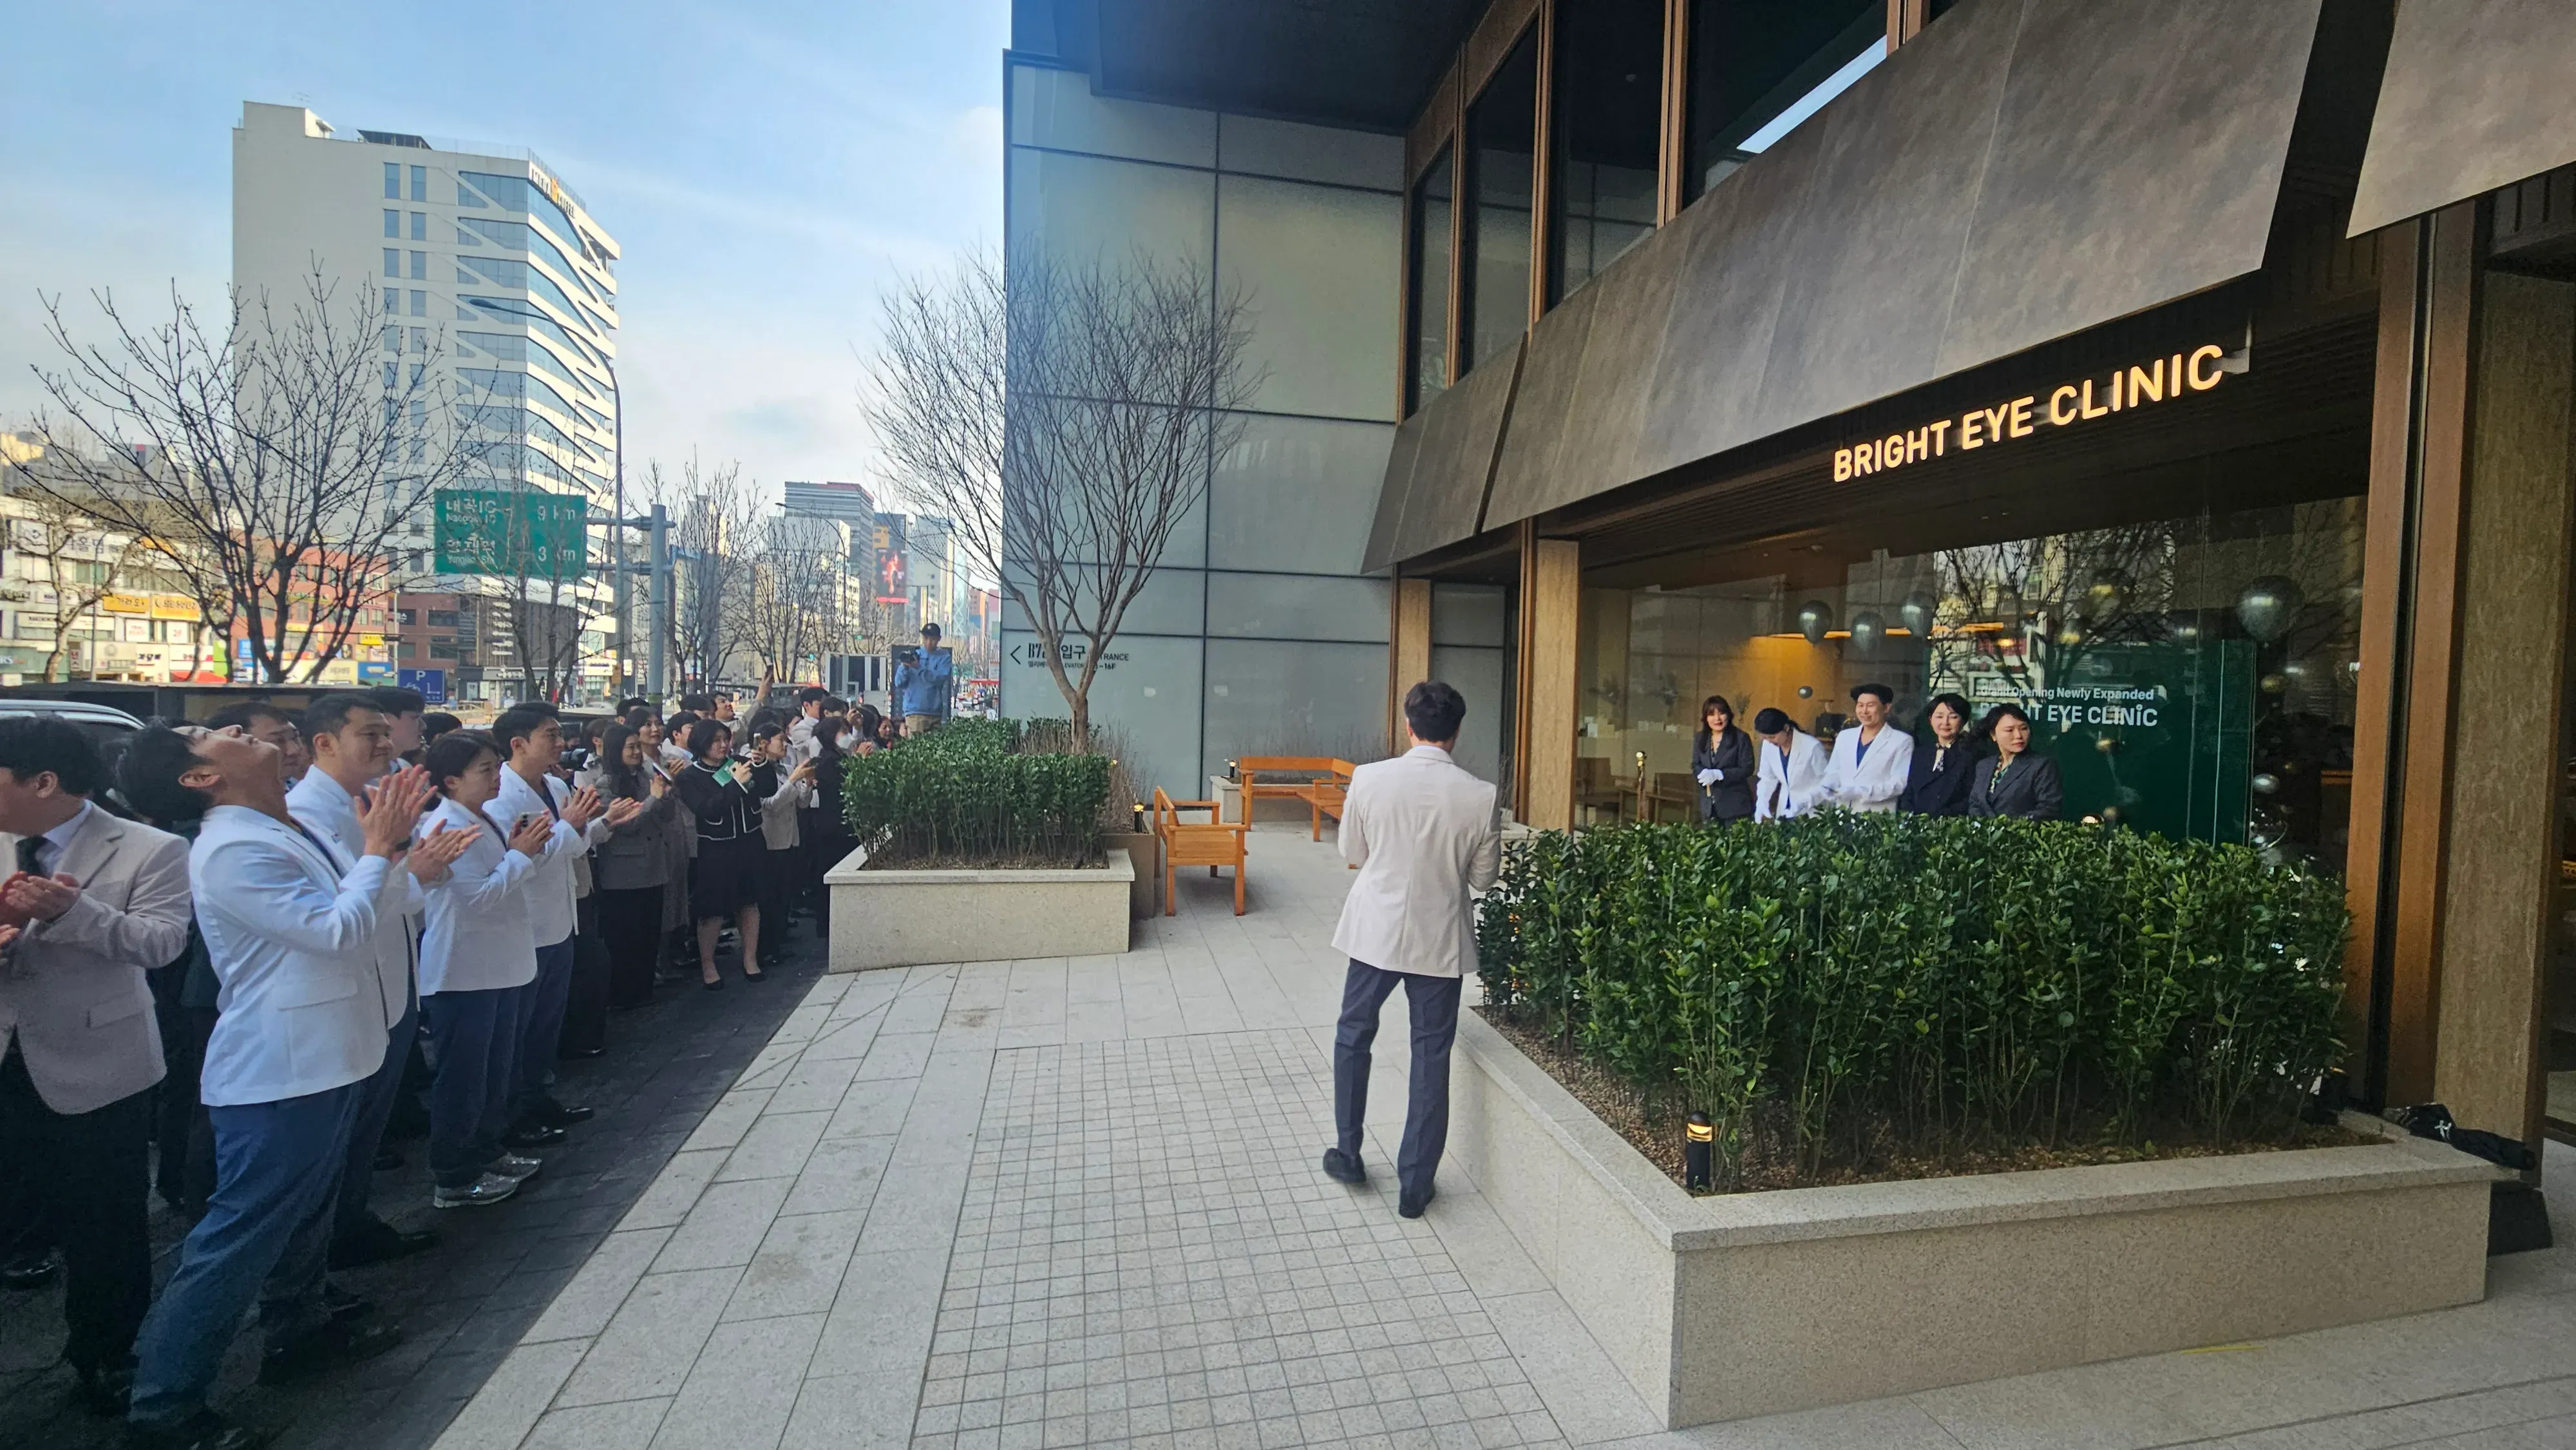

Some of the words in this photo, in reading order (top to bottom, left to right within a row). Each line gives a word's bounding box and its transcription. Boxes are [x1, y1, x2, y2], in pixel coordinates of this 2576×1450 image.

[1833, 419, 1951, 483] BRIGHT
[1961, 395, 2035, 451] EYE
[2049, 344, 2224, 426] CLINIC
[538, 505, 545, 521] 9
[538, 546, 546, 562] 3
[1061, 645, 1086, 659] 입구
[416, 670, 426, 681] P
[2012, 686, 2055, 700] Opening
[2056, 687, 2091, 701] Newly
[2093, 688, 2154, 701] Expanded
[2047, 704, 2083, 723] EYE
